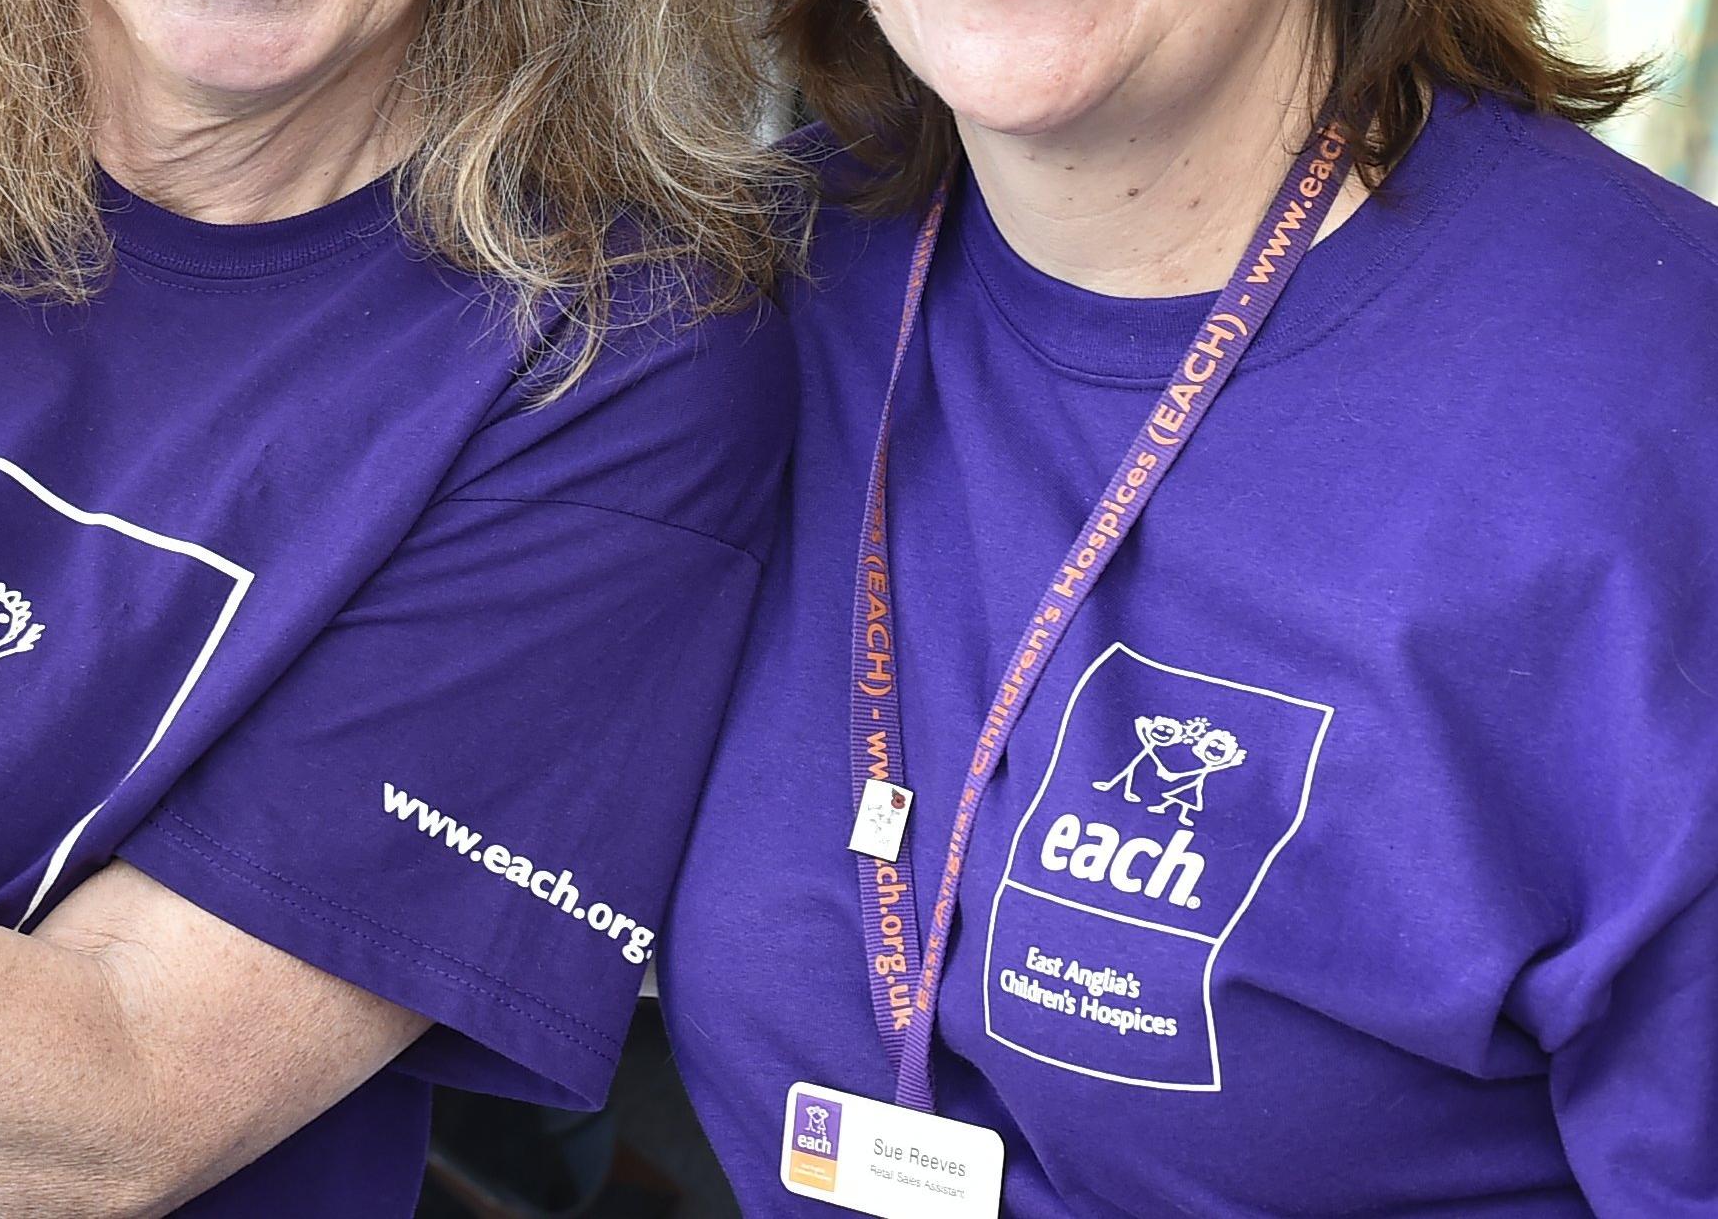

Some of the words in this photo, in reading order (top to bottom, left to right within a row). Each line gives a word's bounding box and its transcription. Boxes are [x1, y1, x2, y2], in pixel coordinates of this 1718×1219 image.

[971, 606, 1062, 776] Children's
[1053, 450, 1158, 598] Hospices
[1148, 313, 1248, 446] (EACH)
[858, 554, 894, 697] (EACH)
[1025, 946, 1064, 978] East
[1064, 960, 1141, 998] Anglia's
[1000, 968, 1077, 1015] Children's
[1080, 995, 1178, 1036] Hospices
[797, 1133, 833, 1155] each
[873, 1137, 904, 1161] Sue
[909, 1147, 967, 1178] Reeves
[897, 1171, 922, 1189] Sales
